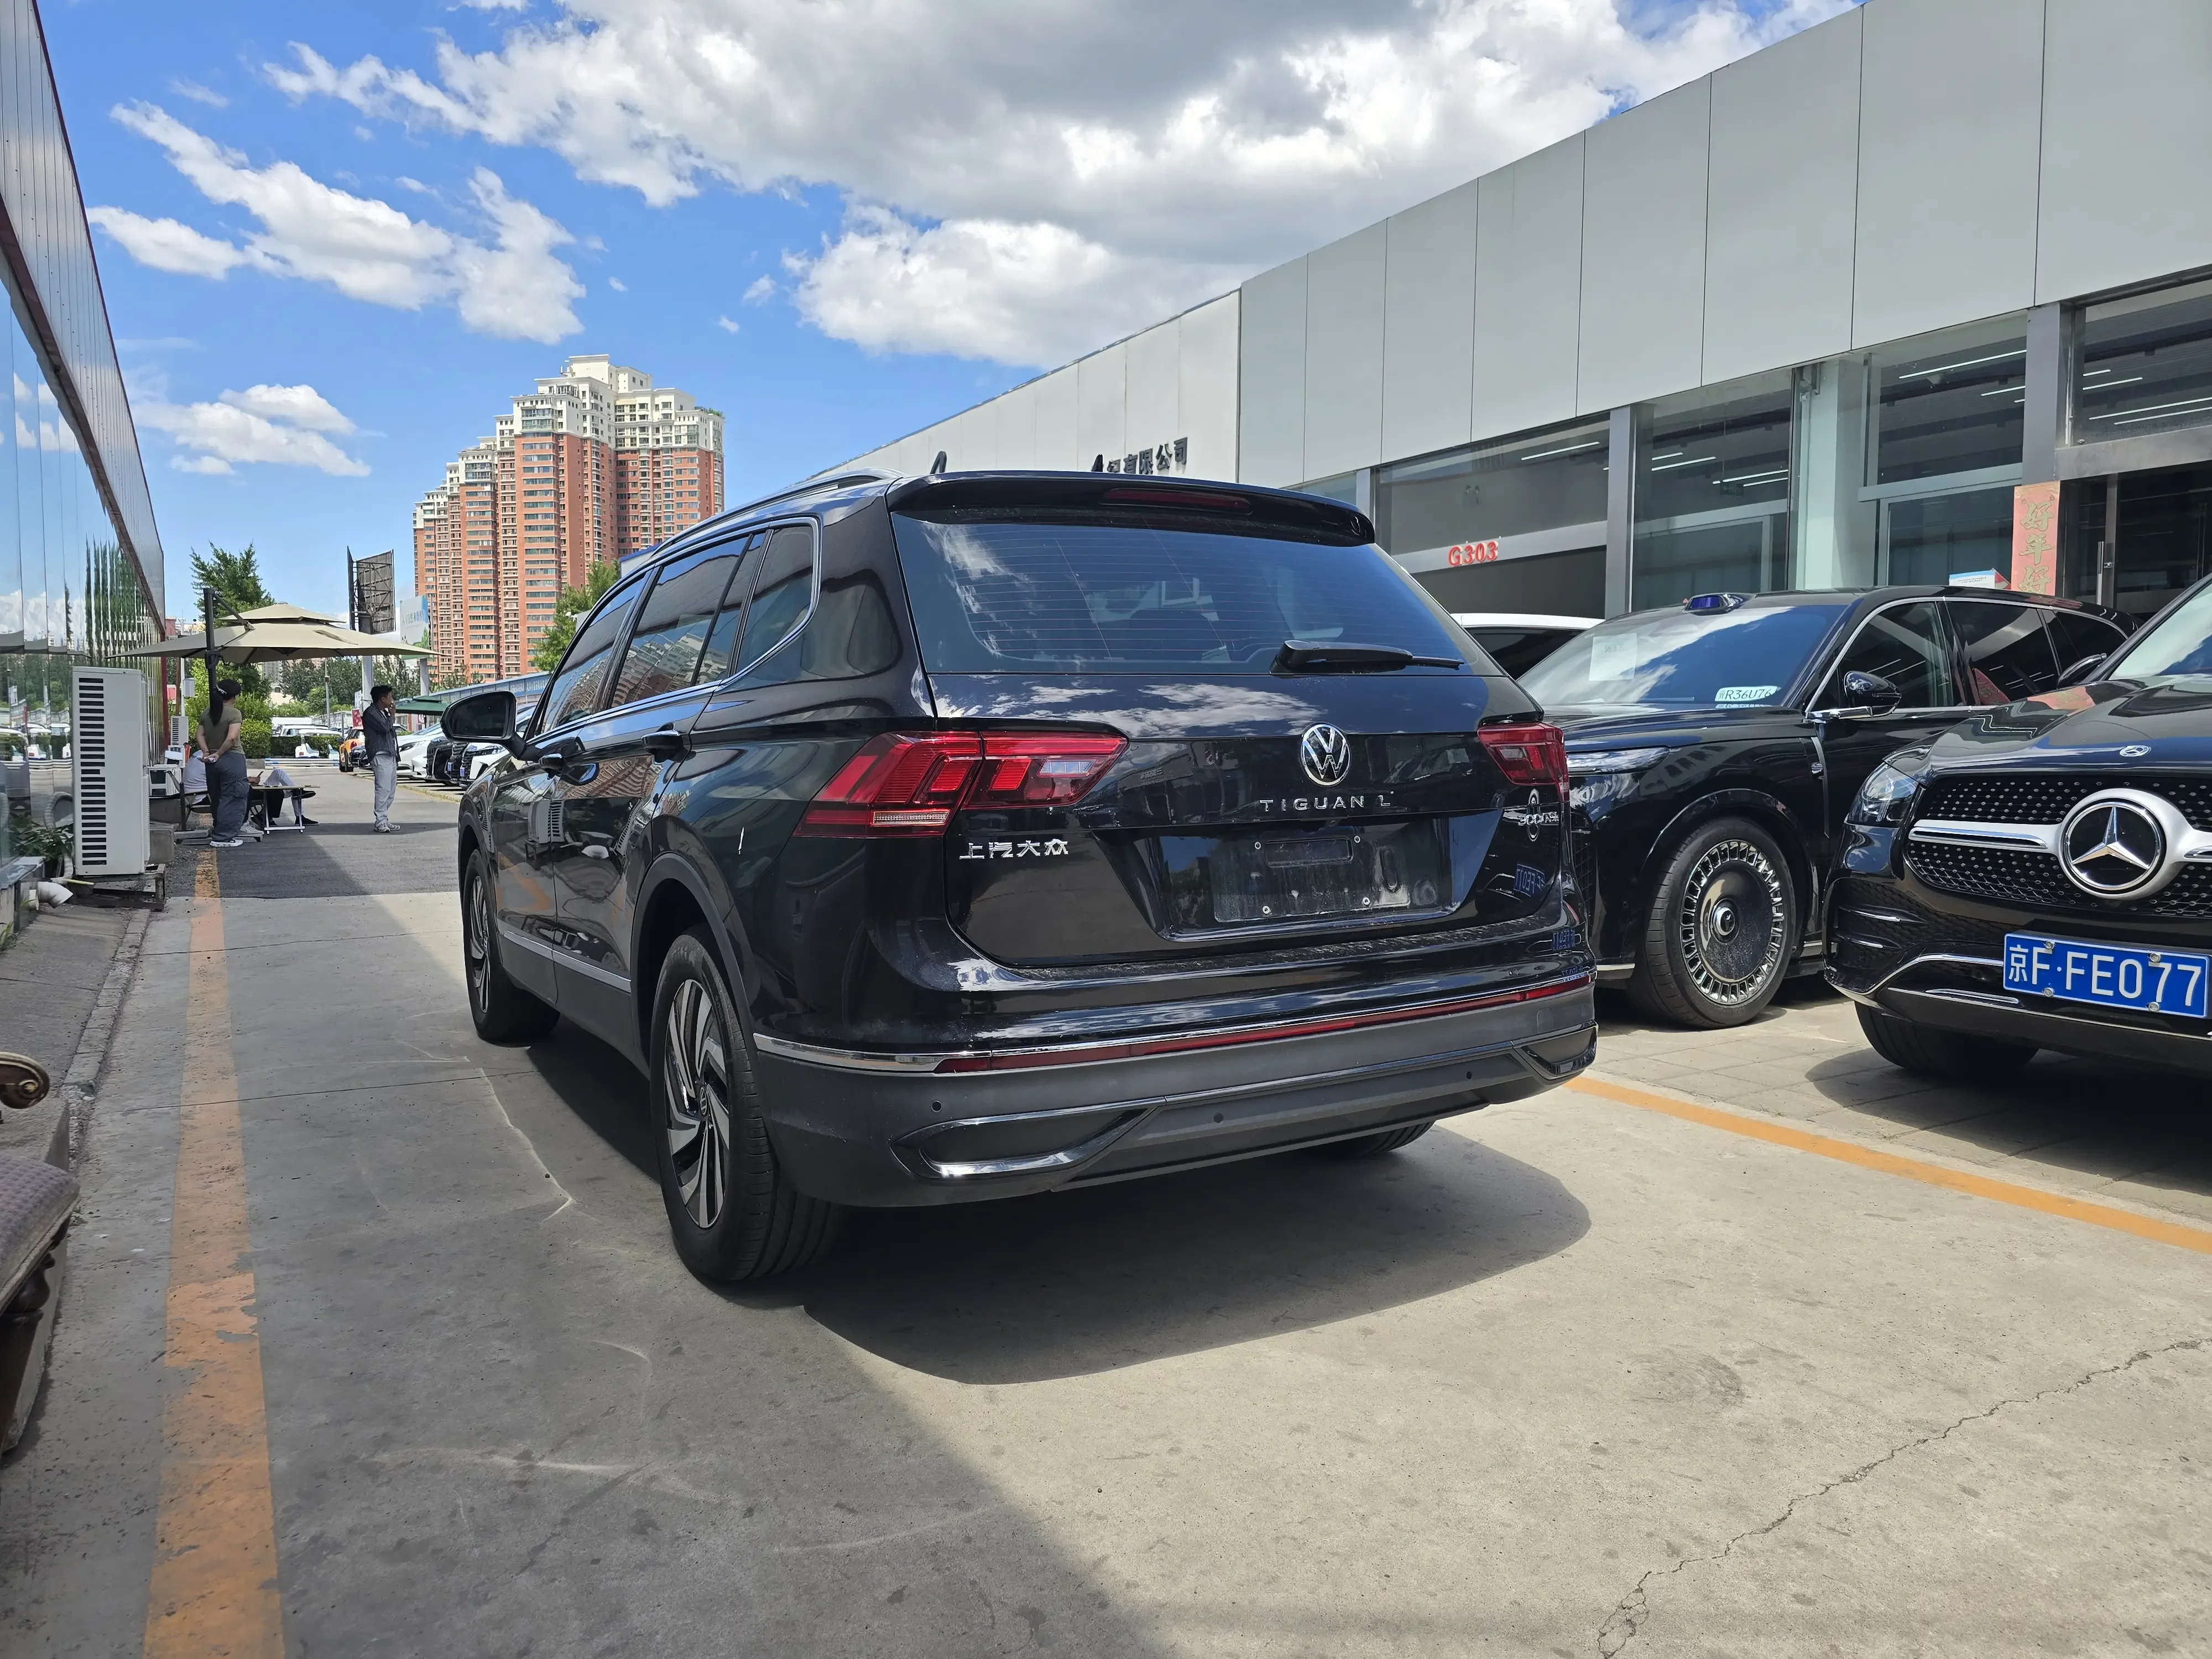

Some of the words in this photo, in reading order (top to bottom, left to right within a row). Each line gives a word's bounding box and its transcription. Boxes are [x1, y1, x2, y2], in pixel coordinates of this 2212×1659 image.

[1448, 540, 1499, 567] G303
[1259, 795, 1364, 812] TIGUAN
[1378, 795, 1391, 807] L
[959, 838, 1068, 860] 上汽大众
[2008, 944, 2201, 1006] 京F·FE077
